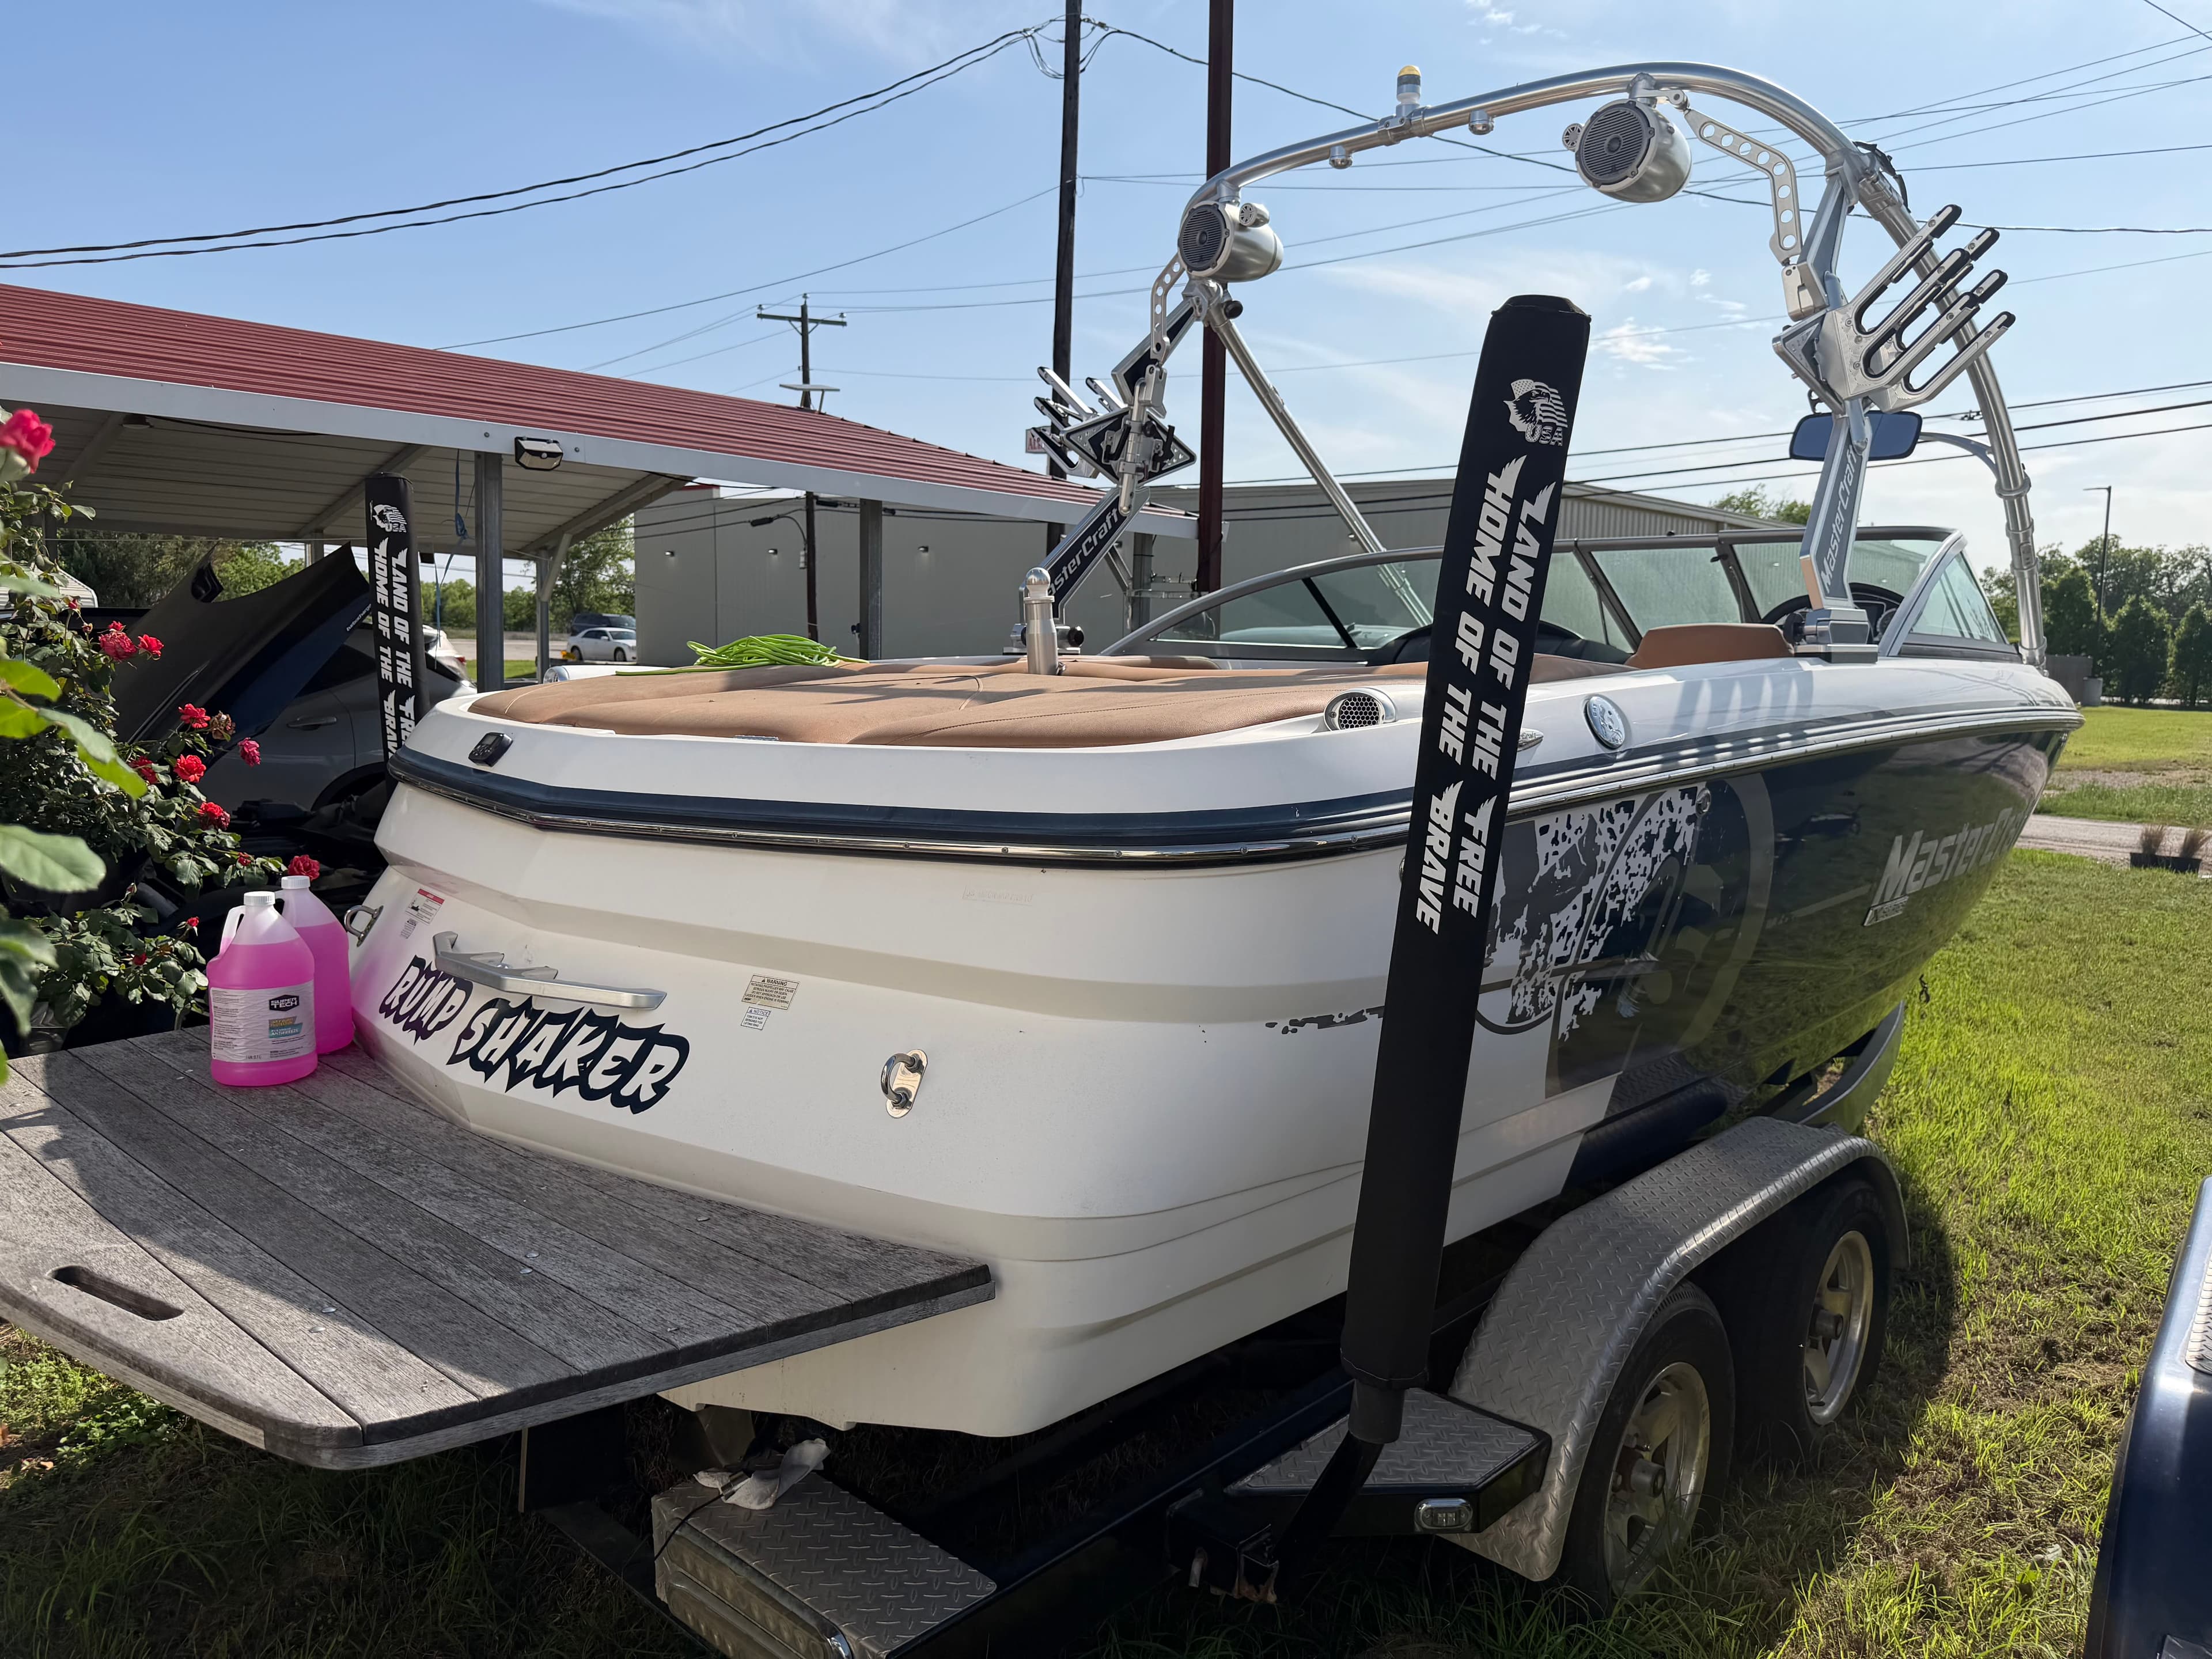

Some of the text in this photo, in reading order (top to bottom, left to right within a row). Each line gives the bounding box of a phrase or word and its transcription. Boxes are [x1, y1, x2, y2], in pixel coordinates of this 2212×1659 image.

[1525, 422, 1564, 446] USA
[1048, 507, 1119, 596] asterCraft
[1820, 444, 1858, 594] MasterCraft
[374, 537, 389, 608] HOME
[378, 611, 391, 640] OF
[380, 646, 393, 683] THE
[392, 548, 415, 745] LAND OF THE FRE
[1416, 454, 1528, 935] HOME OF THE BRAVE
[1453, 481, 1556, 918] LAND OF THE FREE
[767, 978, 787, 987] WARNING
[380, 956, 690, 1113] RUMP SHAKER
